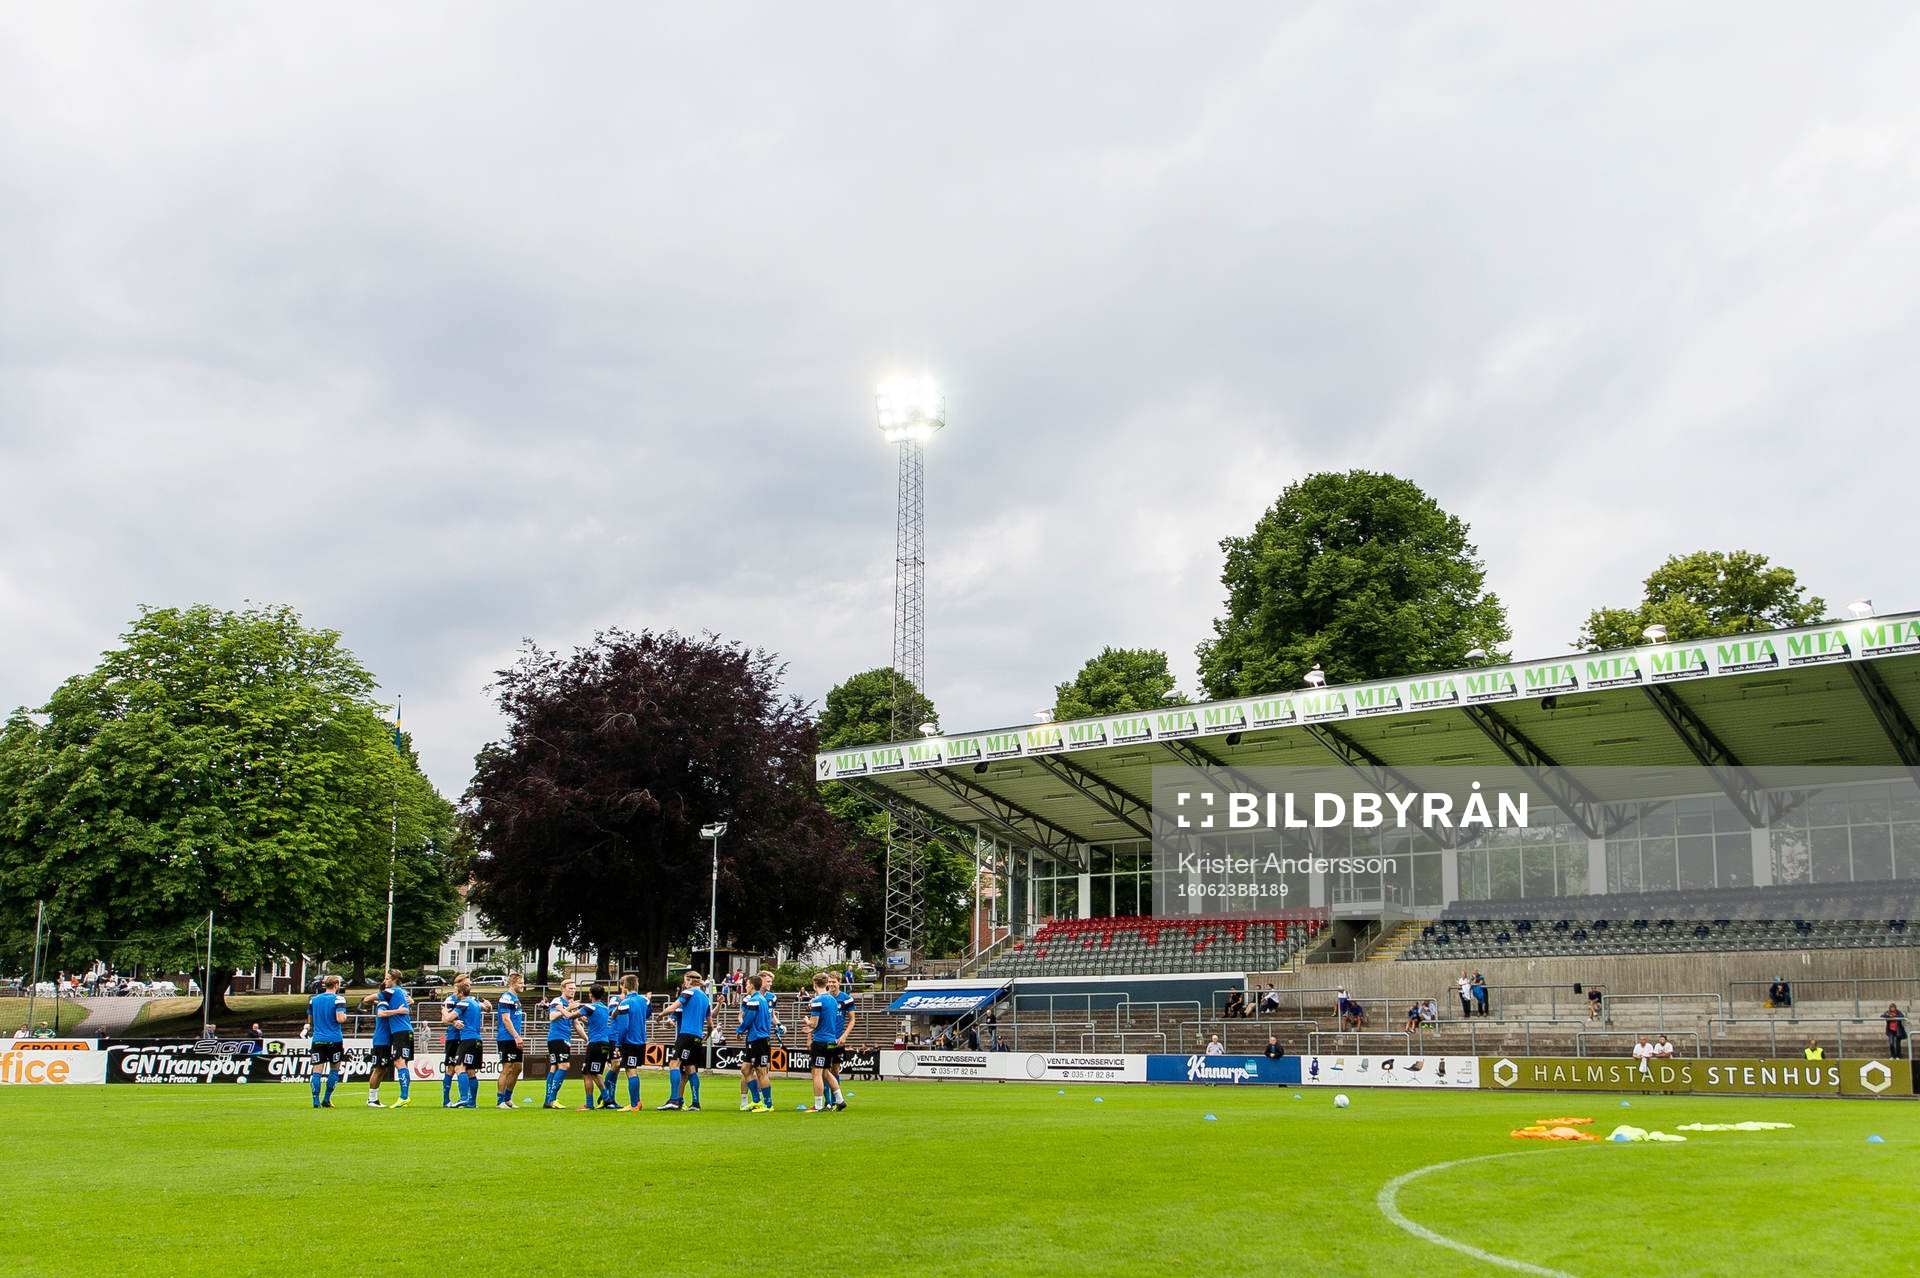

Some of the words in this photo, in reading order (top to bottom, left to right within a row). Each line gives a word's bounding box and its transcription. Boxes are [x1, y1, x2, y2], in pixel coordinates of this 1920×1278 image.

[1786, 630, 1851, 658] MTA
[1860, 620, 1920, 648] MTA
[1650, 648, 1709, 673] MTA
[1717, 639, 1778, 666] MTA
[1525, 664, 1578, 688] MTA
[1587, 656, 1642, 681] MTA
[1410, 679, 1459, 701] MTA
[1466, 671, 1517, 694] MTA
[1303, 692, 1348, 715] MTA
[1355, 685, 1402, 708] MTA
[1204, 705, 1246, 726] MTA
[1253, 699, 1296, 721] MTA
[1069, 722, 1106, 742] MTA
[1112, 717, 1151, 737] MTA
[1157, 711, 1198, 732] MTA
[947, 738, 982, 756] MTA
[986, 733, 1021, 752] MTA
[1027, 727, 1063, 747] MTA
[836, 753, 867, 770] MTA
[872, 748, 904, 766] MTA
[909, 742, 942, 761] MTA
[917, 1055, 987, 1064] VENTILATIONSSERVICE
[1047, 1057, 1125, 1066] VENTILATIONSSERVICE
[970, 1068, 978, 1076] 84
[1072, 1070, 1094, 1078] 035-17
[1106, 1071, 1114, 1079] 84
[1534, 1065, 1693, 1084] HALMSTADS
[1707, 1066, 1839, 1086] STENHUS
